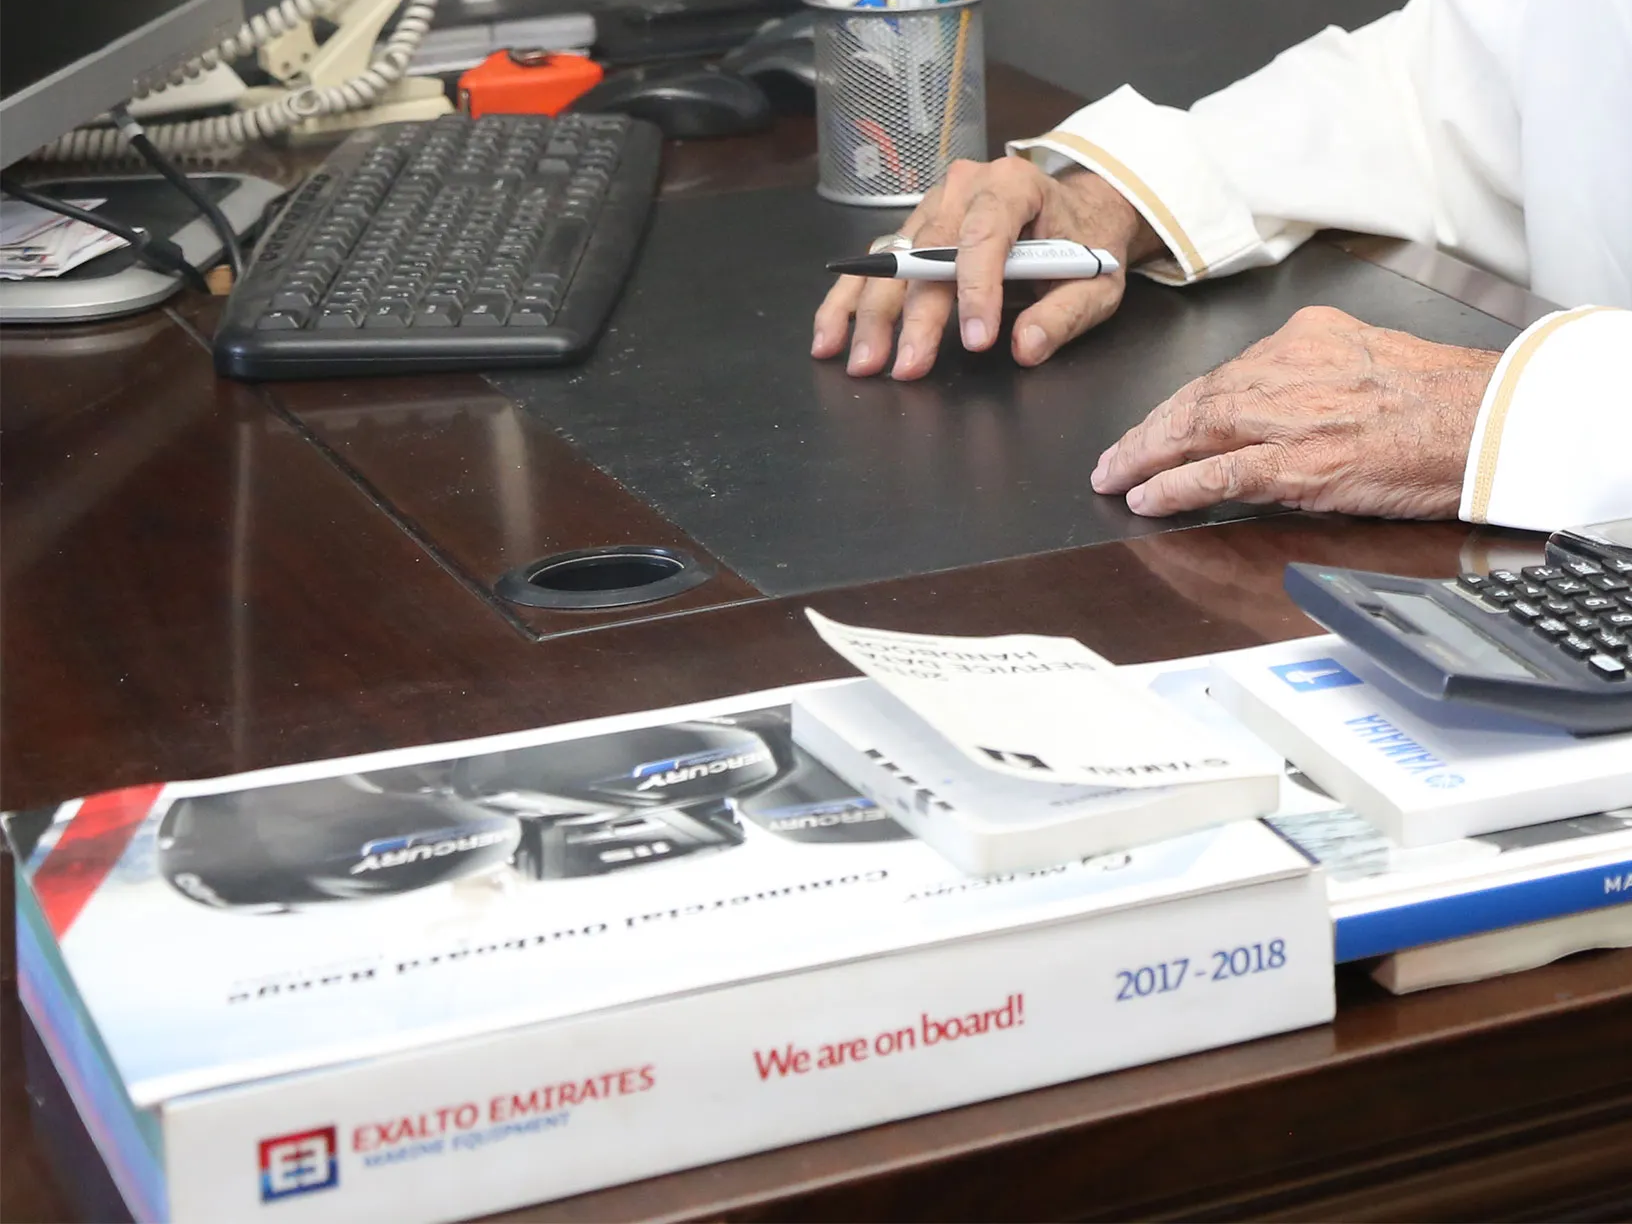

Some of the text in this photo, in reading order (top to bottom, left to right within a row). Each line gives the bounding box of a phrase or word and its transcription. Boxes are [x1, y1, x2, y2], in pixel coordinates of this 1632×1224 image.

[1343, 713, 1448, 775] YAMAHA
[769, 809, 890, 831] ERCURY
[625, 868, 889, 928] Commercial
[396, 923, 608, 975] Outboard
[1115, 957, 1191, 1002] 2017
[1211, 938, 1287, 982] 2018
[753, 992, 1026, 1082] We are on board!
[352, 1063, 658, 1154] EXALTO EMIRATES
